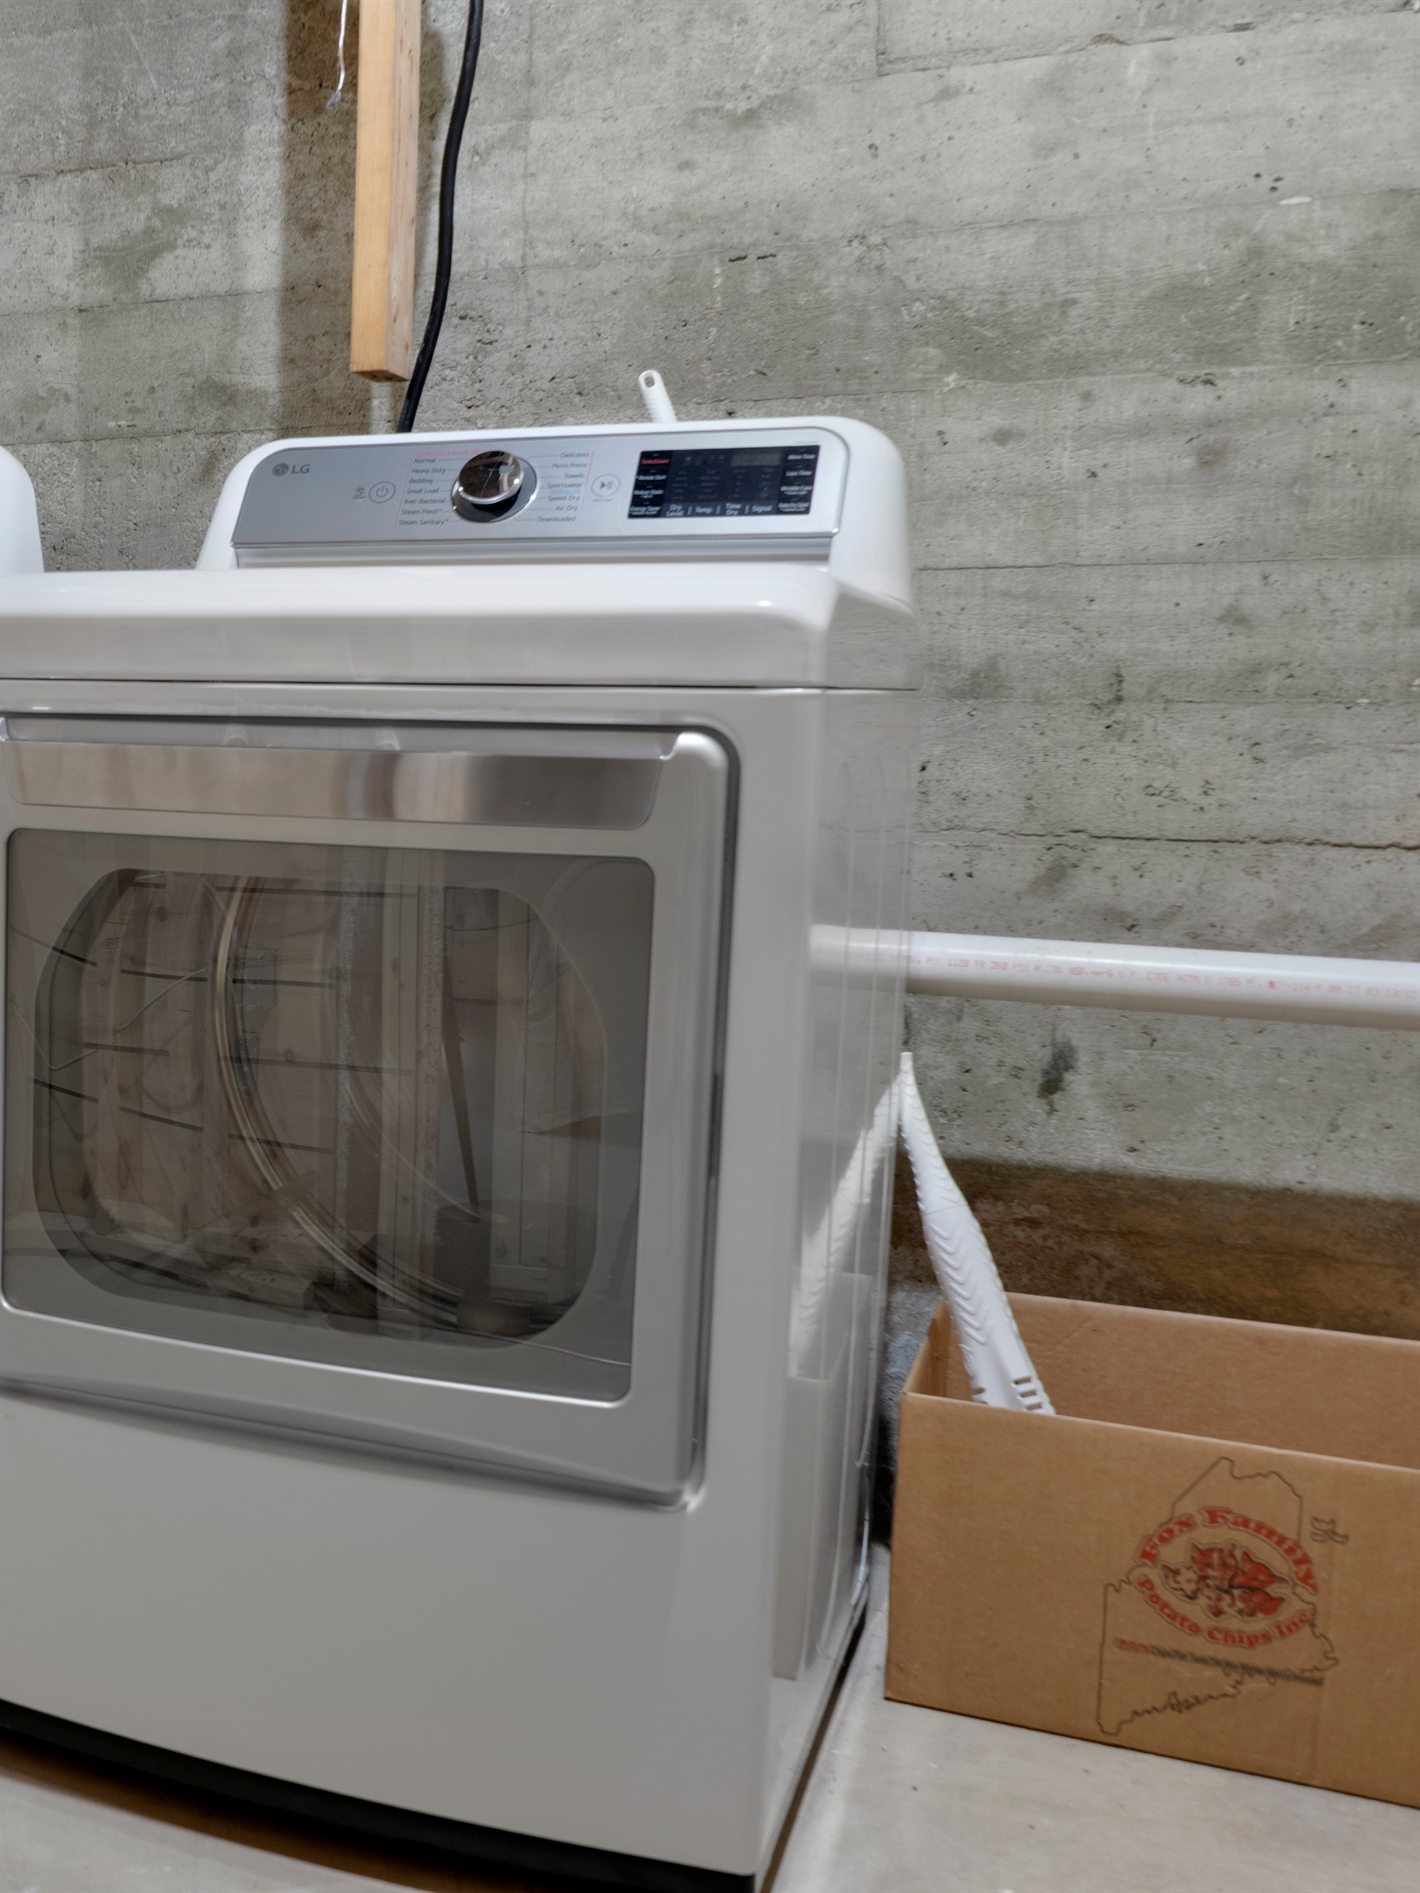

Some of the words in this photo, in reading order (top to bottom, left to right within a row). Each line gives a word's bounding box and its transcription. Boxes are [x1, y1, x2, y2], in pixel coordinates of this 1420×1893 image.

[291, 464, 310, 474] LG
[1137, 1513, 1197, 1565] Fox
[1202, 1507, 1319, 1592] Family
[1136, 1574, 1202, 1636] Potato
[1205, 1626, 1274, 1649] Chips
